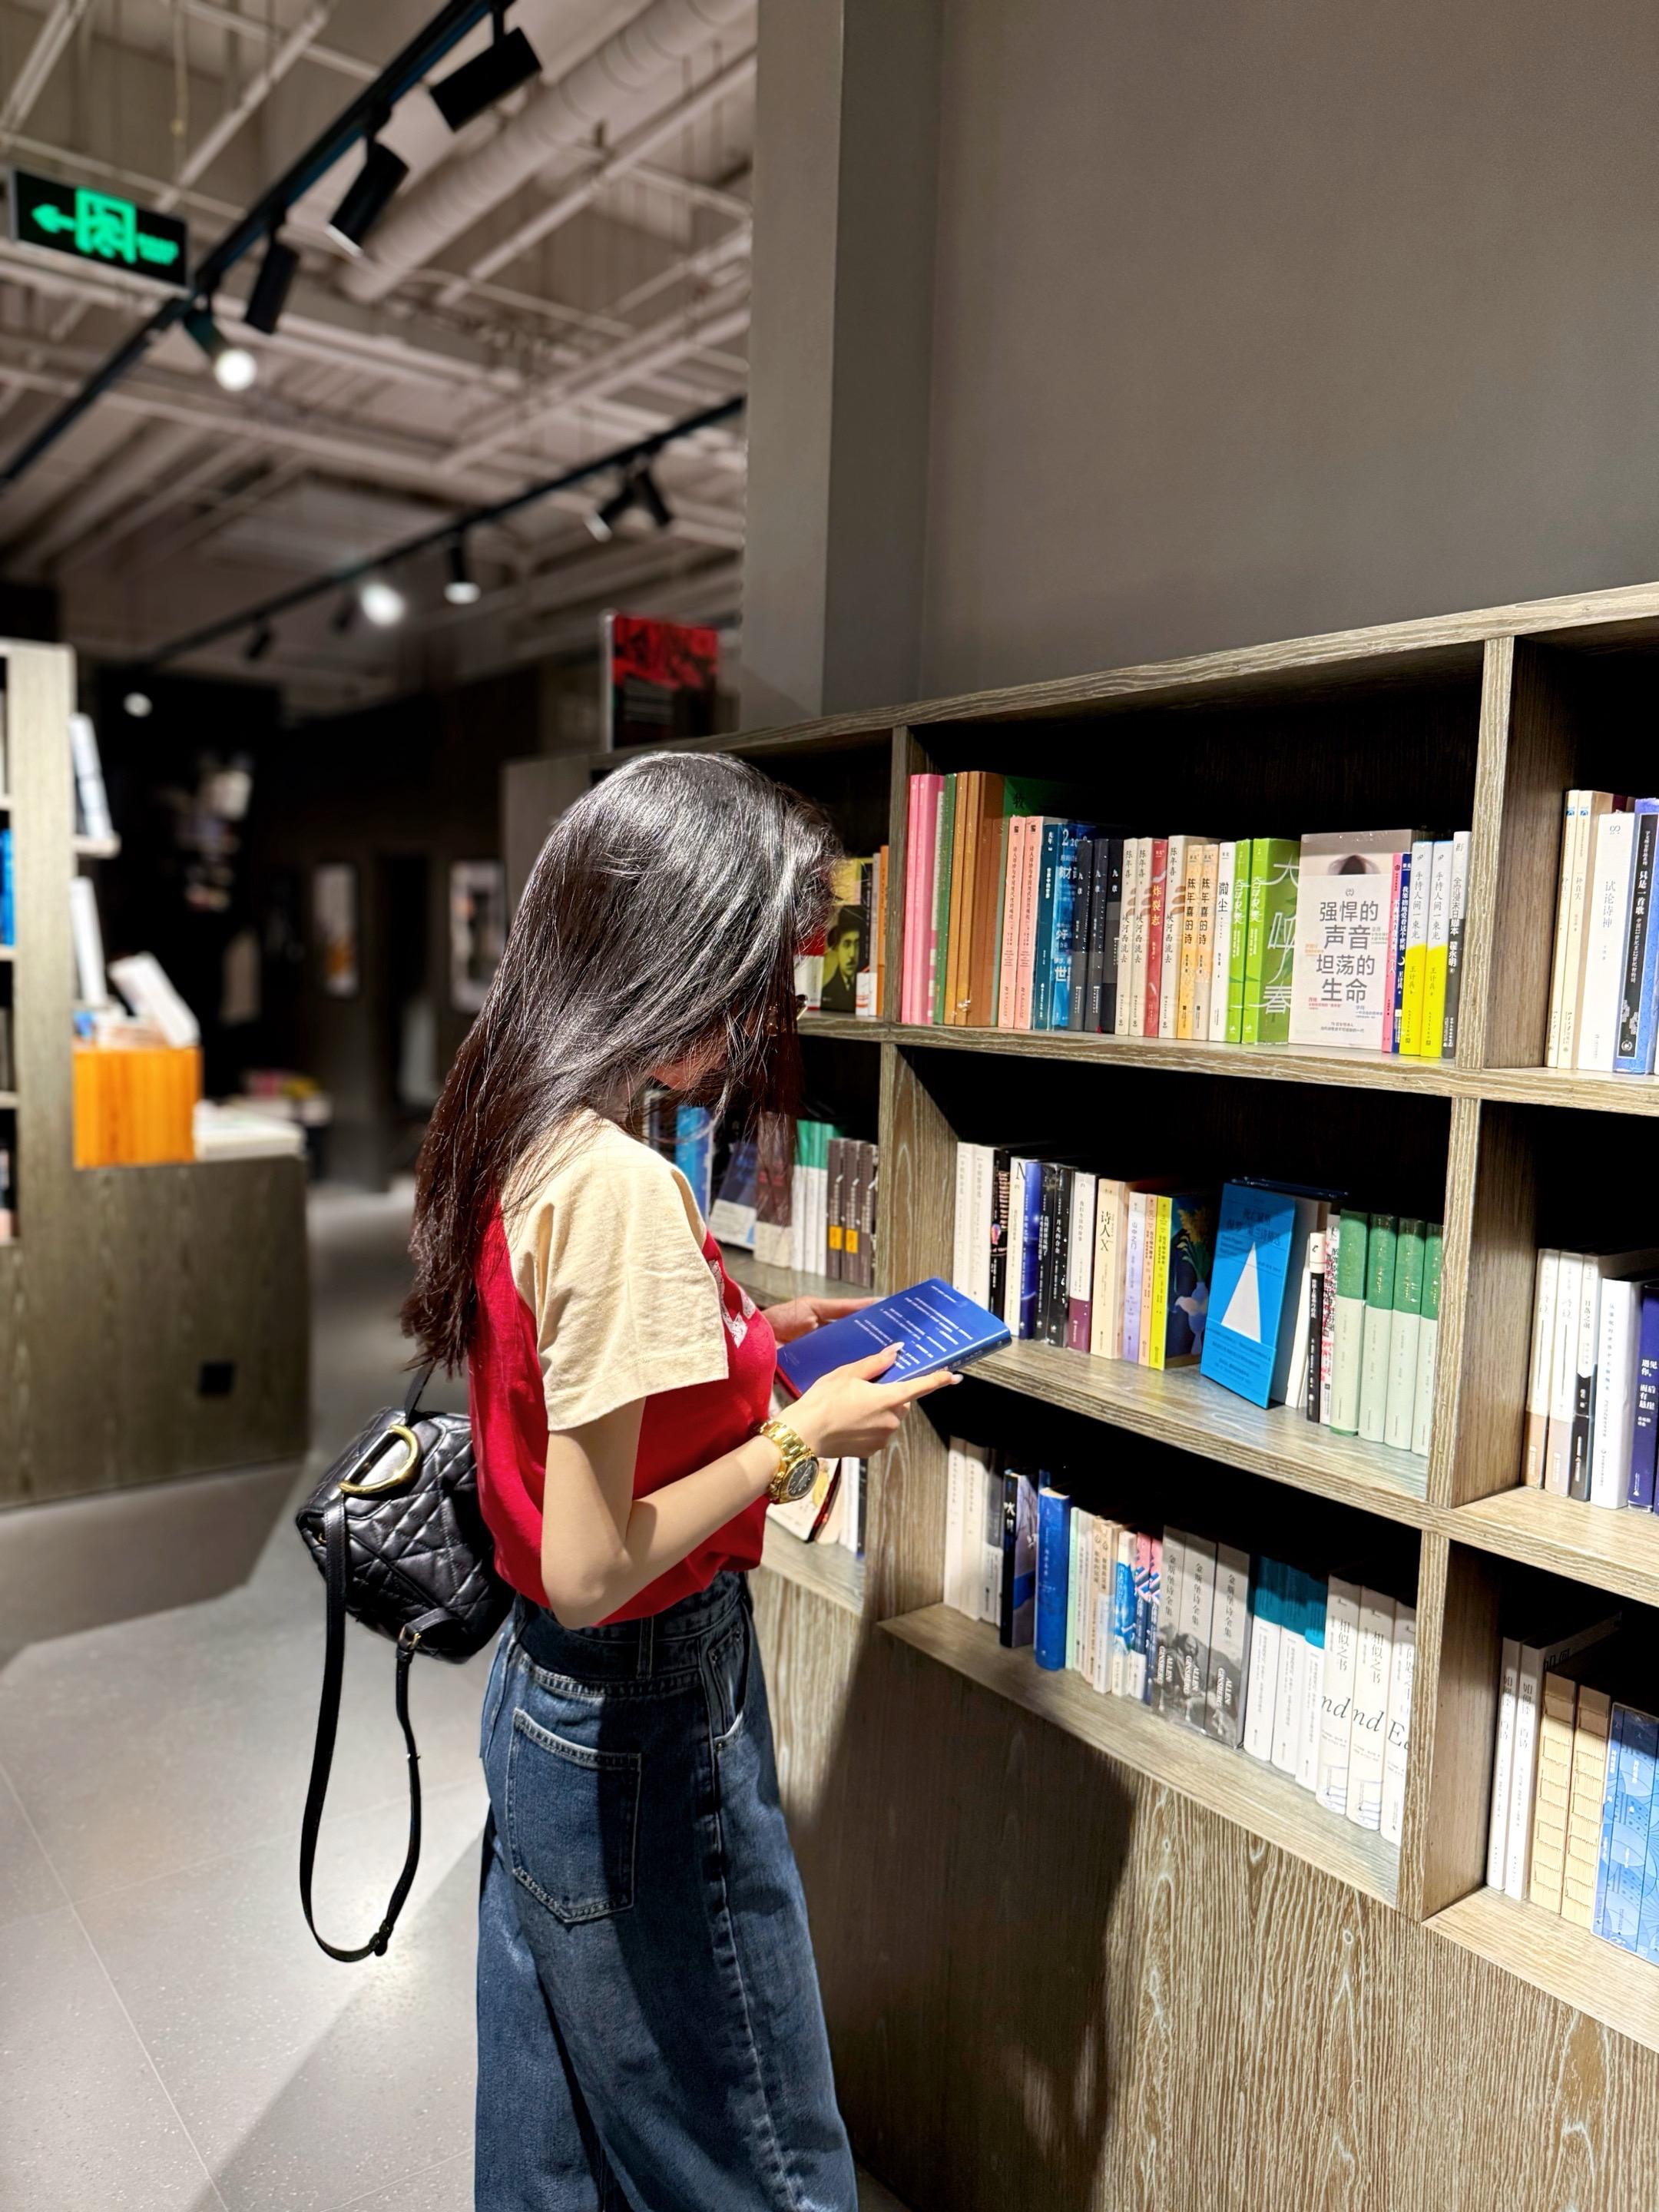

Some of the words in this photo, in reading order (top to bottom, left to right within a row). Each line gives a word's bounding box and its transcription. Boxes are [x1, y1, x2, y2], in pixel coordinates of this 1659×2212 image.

[1151, 885, 1162, 926] 炸裂志
[1184, 878, 1196, 944] 陈年喜的诗
[1199, 878, 1210, 945] 陈年喜的诗
[1218, 882, 1229, 912] 微尘
[1320, 900, 1379, 922] 强悍的
[1412, 871, 1422, 939] 手持人间一束光
[1432, 872, 1443, 939] 手持人间一束光
[1635, 870, 1648, 916] 只是一首歌
[1324, 925, 1371, 950] 声音
[1316, 954, 1376, 975] 坦荡的
[1321, 978, 1367, 1003] 生命
[1641, 1359, 1657, 1369] 遇见
[1638, 1400, 1655, 1410] 悬崖
[1640, 1385, 1656, 1394] 而后
[1640, 1392, 1647, 1401] 有
[1165, 1555, 1177, 1616] 金斯堡诗全集
[1192, 1563, 1204, 1627] 金斯堡诗全集
[1224, 1575, 1236, 1637] 金斯堡诗全集
[1337, 1618, 1350, 1671] 相似之书
[1370, 1630, 1384, 1684] 相似之书
[1157, 1645, 1166, 1684] GINSBERG
[1165, 1655, 1174, 1683] ALLEN
[1184, 1655, 1192, 1695] GINSBERG
[1191, 1665, 1200, 1691] ALLEN
[1216, 1667, 1226, 1709] GINSBERG
[1224, 1677, 1233, 1705] ALLEN
